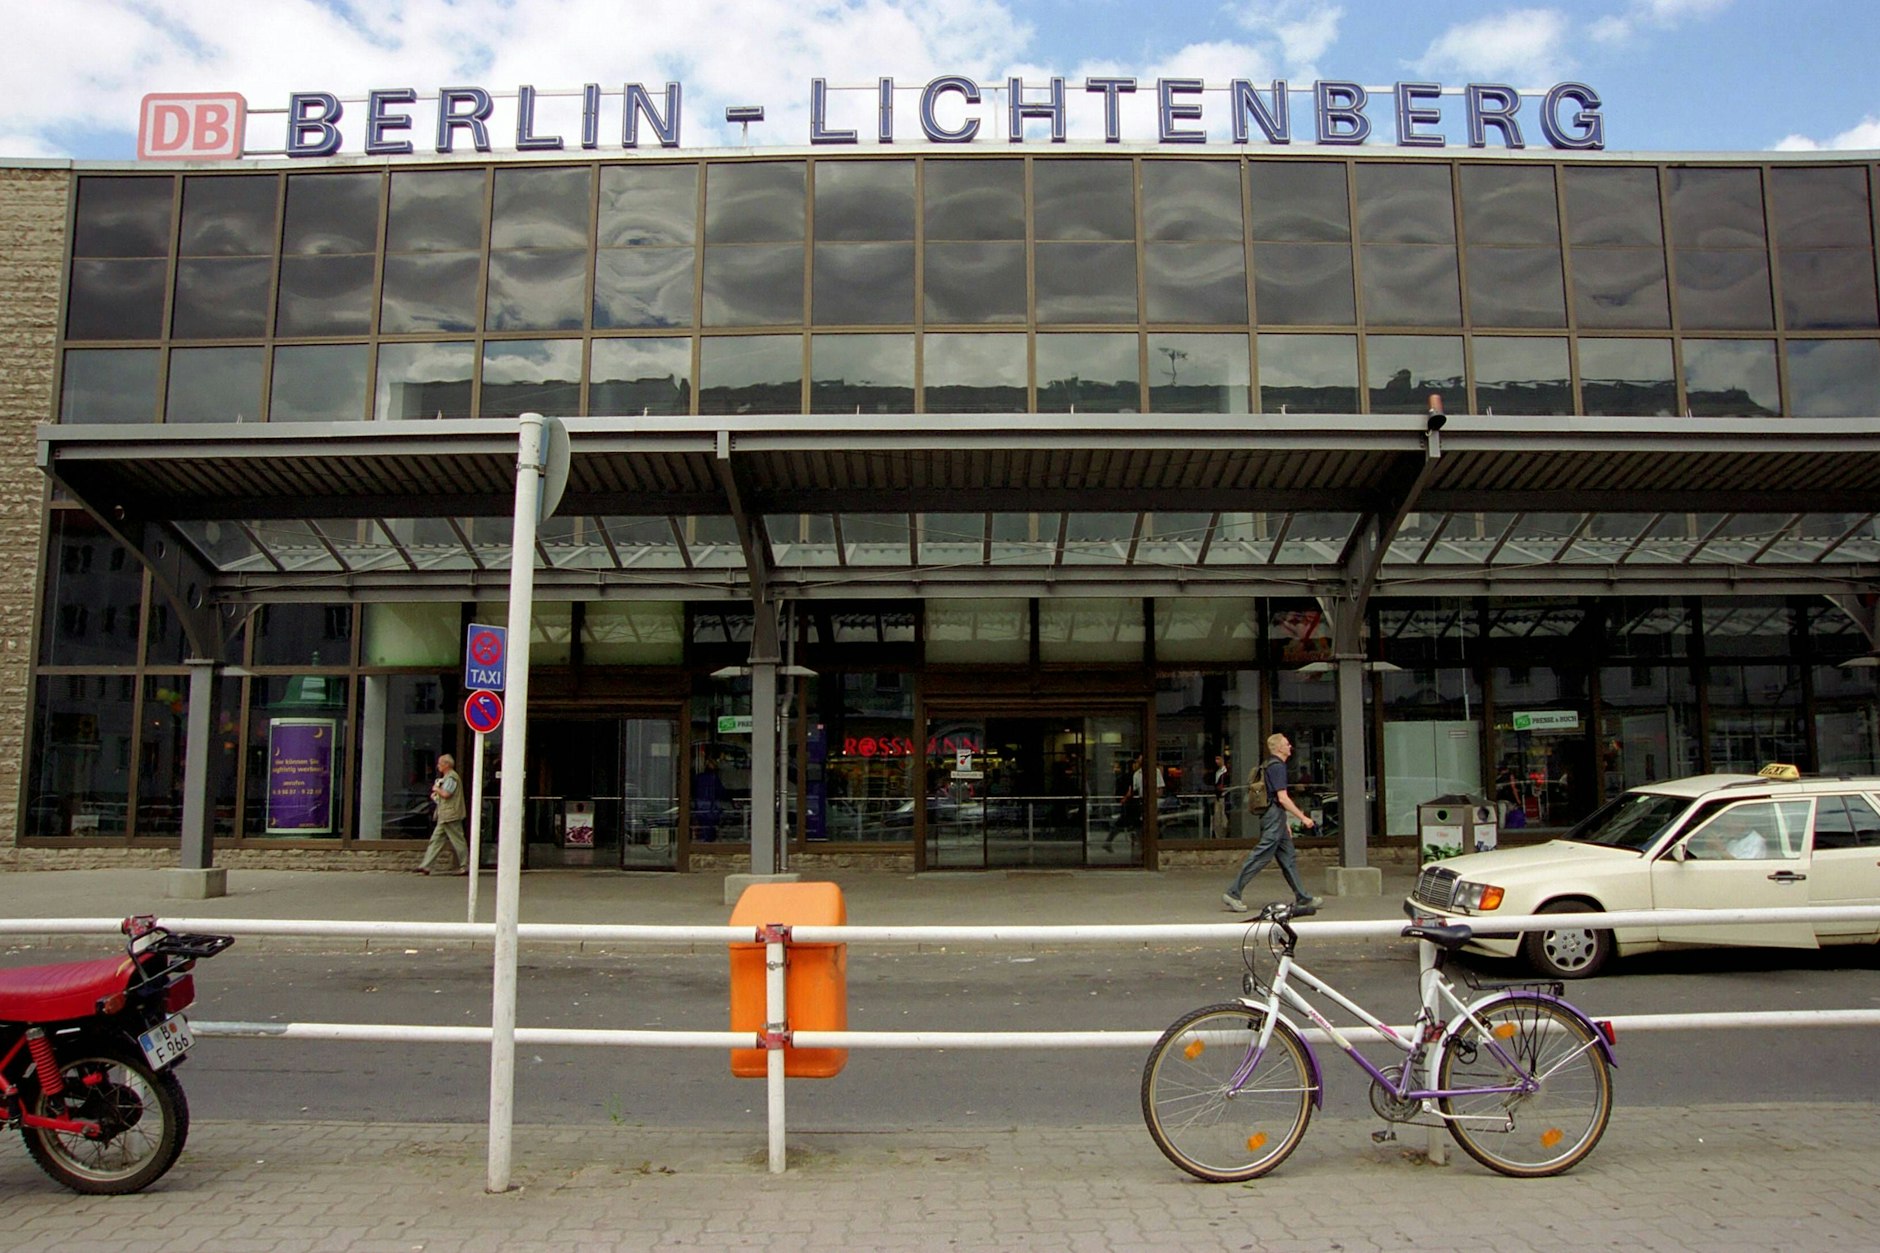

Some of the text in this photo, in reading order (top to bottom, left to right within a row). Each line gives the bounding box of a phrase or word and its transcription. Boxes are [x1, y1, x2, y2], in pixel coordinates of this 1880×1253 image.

[285, 82, 681, 159] BERLIN
[810, 75, 1606, 150] LICHTENBERG
[150, 102, 232, 152] DB
[470, 668, 501, 685] TAXI
[160, 1025, 171, 1041] B
[156, 1047, 165, 1063] F
